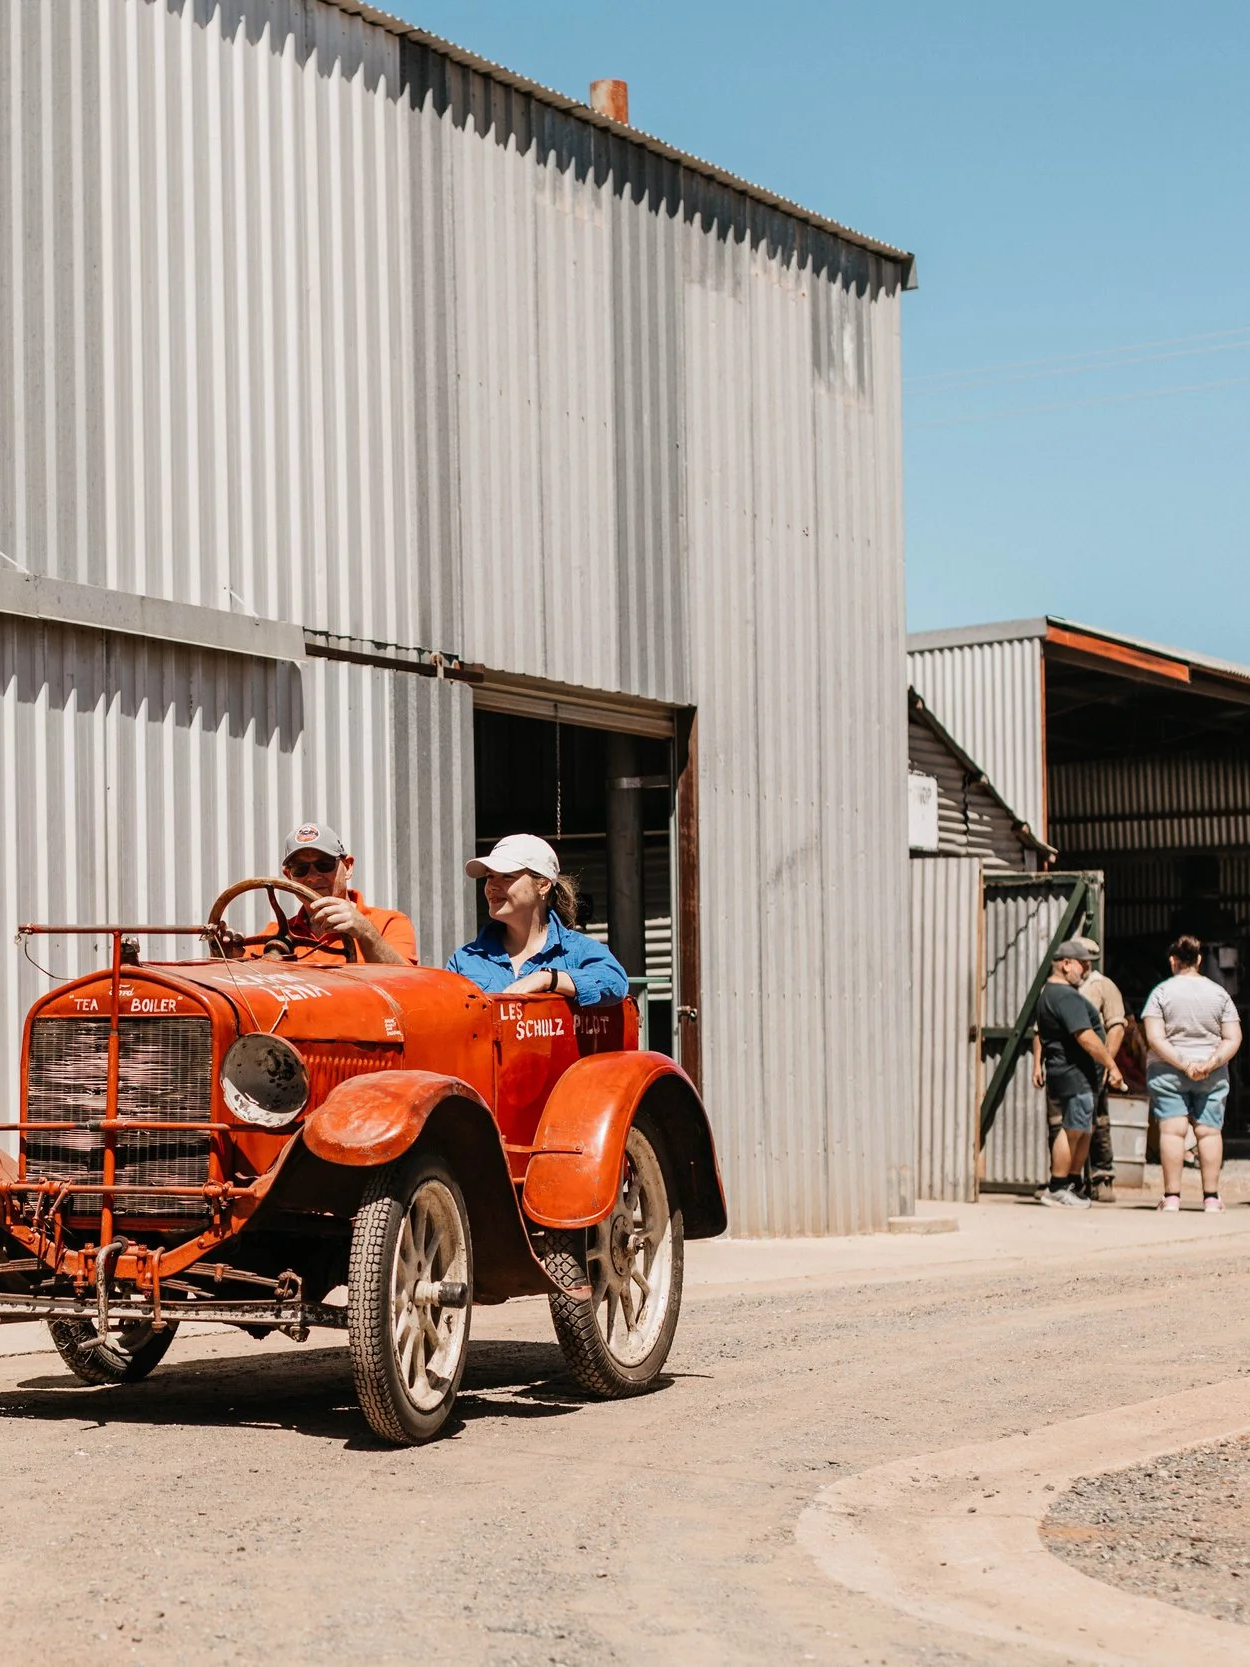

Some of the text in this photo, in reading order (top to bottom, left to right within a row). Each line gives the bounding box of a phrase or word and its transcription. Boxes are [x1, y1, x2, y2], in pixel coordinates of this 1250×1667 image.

[257, 983, 333, 1002] LENA
[500, 1002, 523, 1021] LES
[515, 1013, 610, 1041] SCHULZ PILOT
